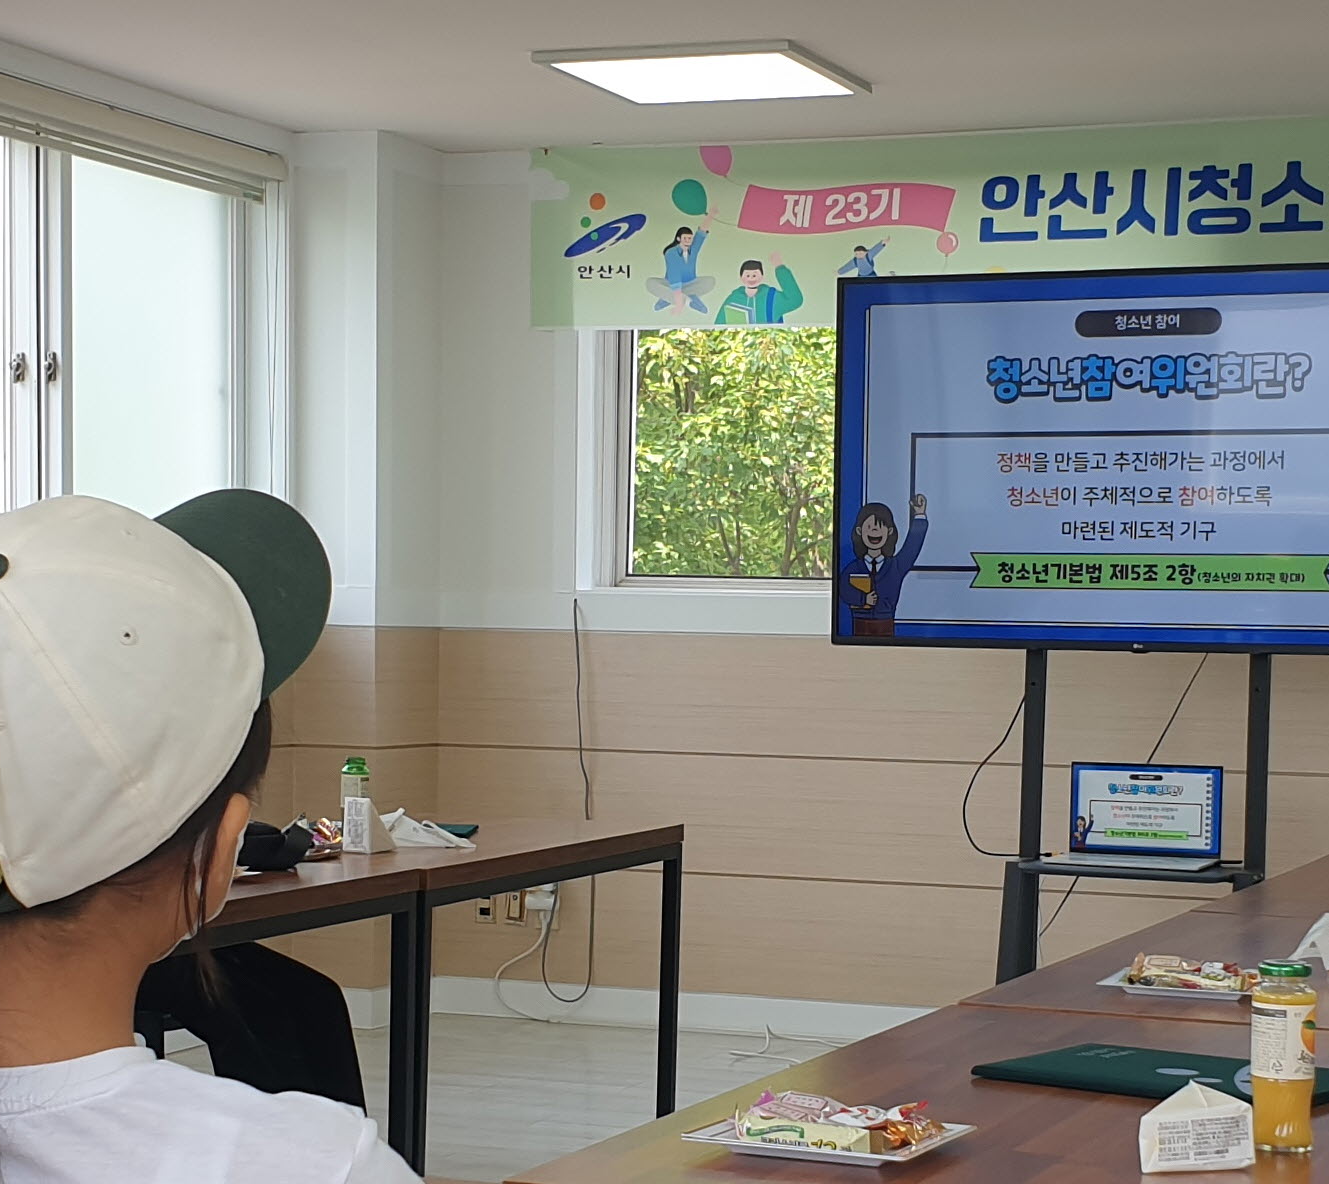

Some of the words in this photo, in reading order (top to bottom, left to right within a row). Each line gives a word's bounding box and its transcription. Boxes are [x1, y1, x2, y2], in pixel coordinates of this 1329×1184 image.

[779, 193, 814, 229] 제
[825, 187, 901, 226] 23기
[577, 264, 632, 279] 안산시
[1114, 314, 1152, 331] 청소년
[1154, 313, 1181, 330] 참여
[987, 351, 1313, 404] 청소년참여위원회란?
[996, 452, 1050, 473] 정책을
[1054, 451, 1108, 473] 만들고
[1112, 451, 1205, 473] 추진해가는
[1209, 450, 1286, 472] 과정에서
[1007, 486, 1077, 507] 청소년이
[1082, 485, 1174, 507] 주체적으로
[1178, 485, 1273, 507] 참여하도록
[1061, 520, 1115, 541] 마련된
[1119, 520, 1174, 541] 제도적
[1179, 520, 1217, 541] 기구
[997, 561, 1103, 584] 청소년기본법
[1109, 562, 1159, 583] 제5조
